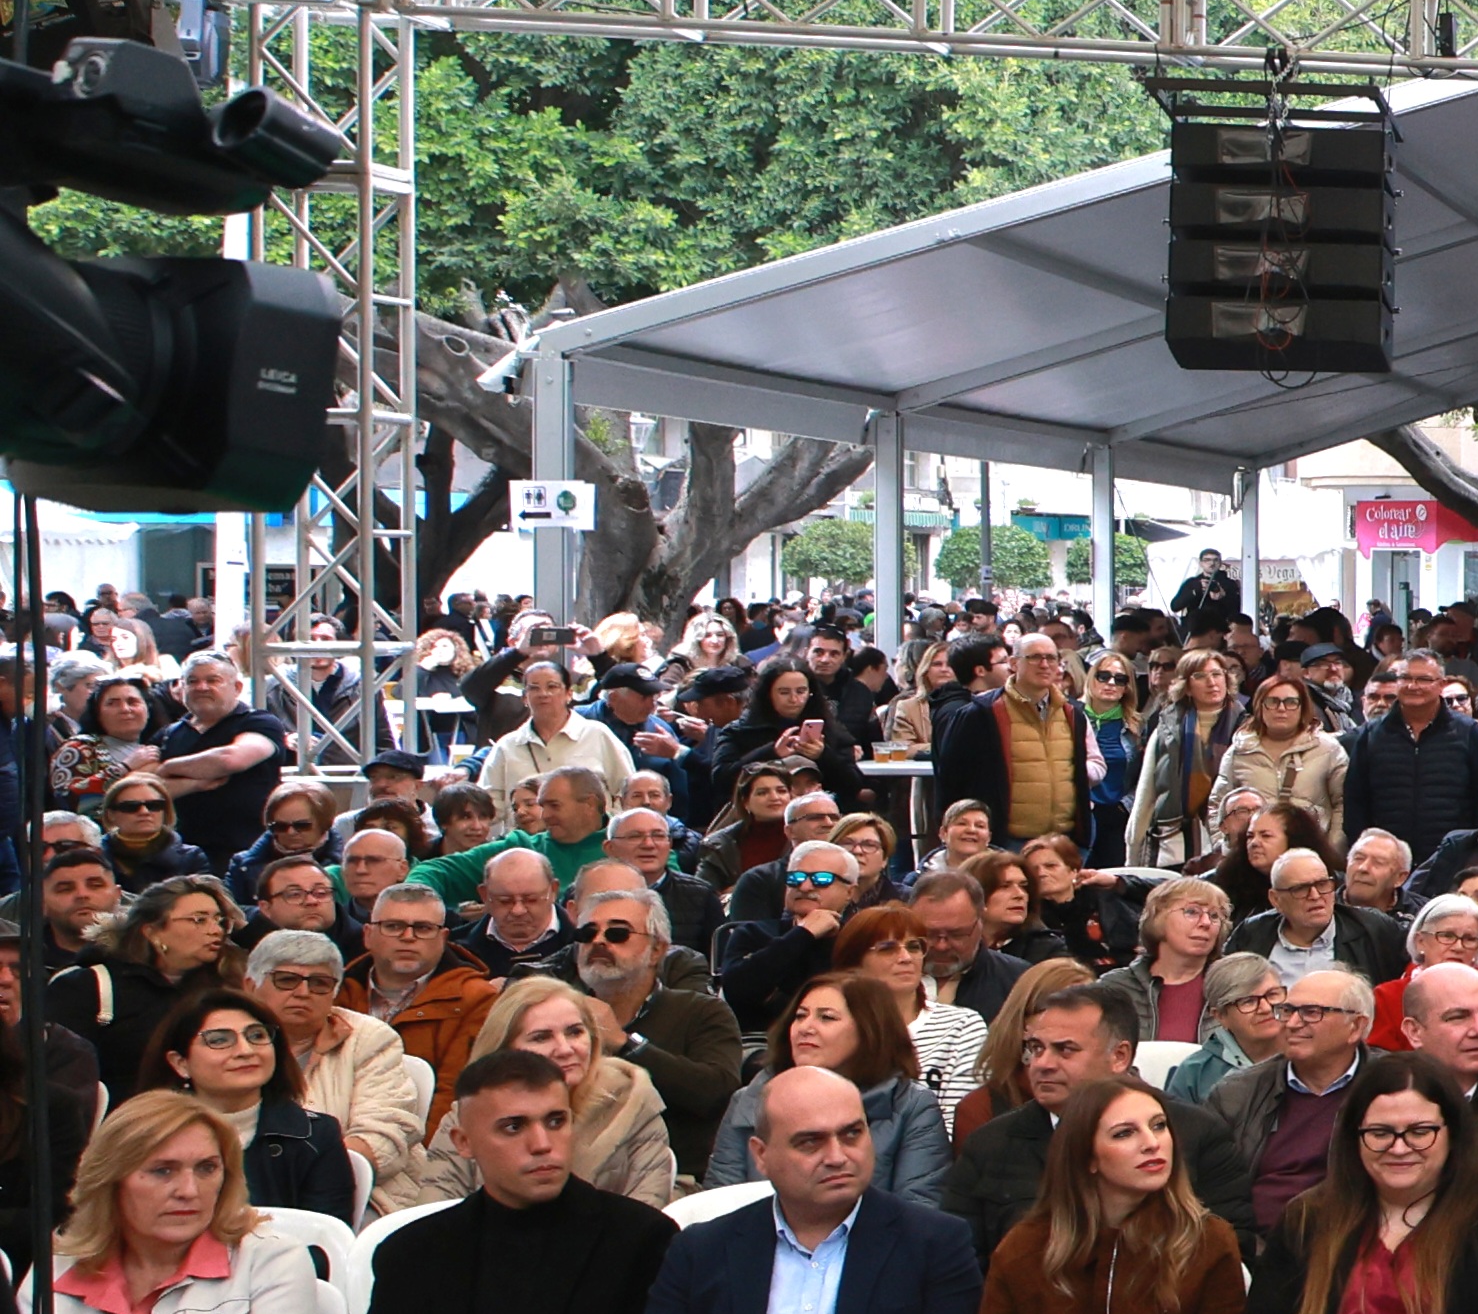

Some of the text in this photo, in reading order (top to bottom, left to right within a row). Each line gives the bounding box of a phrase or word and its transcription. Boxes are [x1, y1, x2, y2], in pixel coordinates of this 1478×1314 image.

[1365, 504, 1412, 522] Colorear
[1378, 522, 1416, 541] el aire
